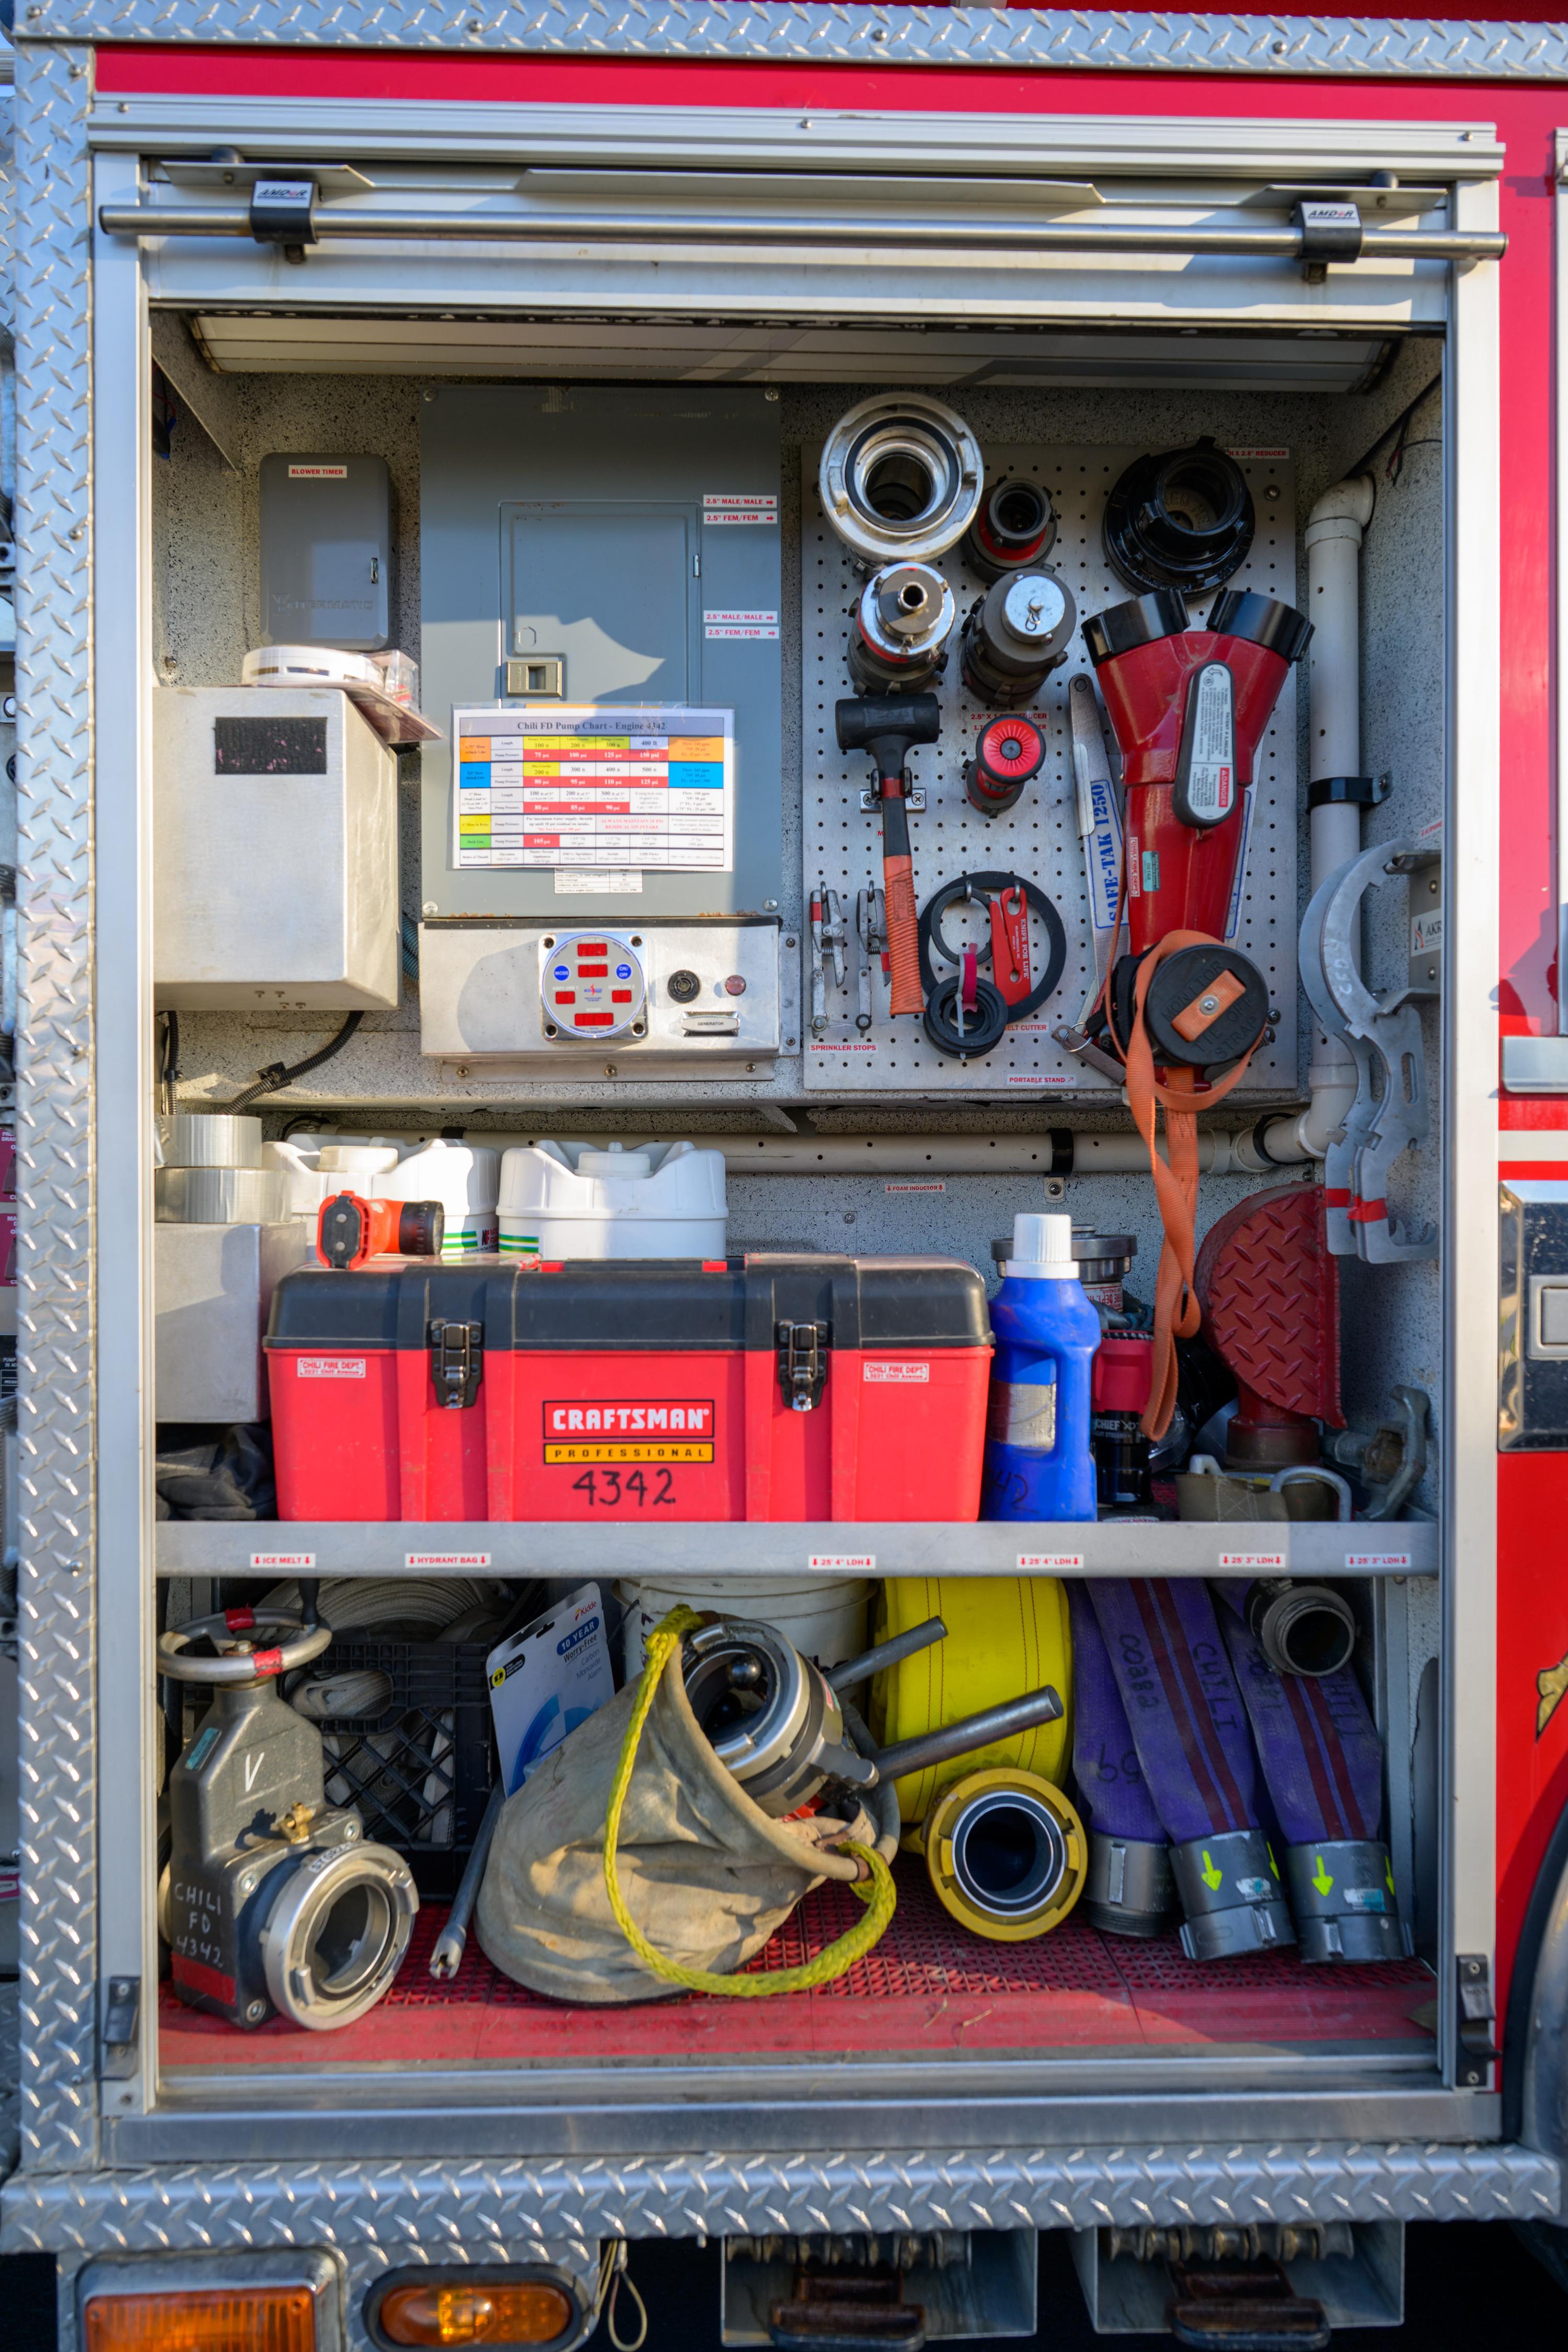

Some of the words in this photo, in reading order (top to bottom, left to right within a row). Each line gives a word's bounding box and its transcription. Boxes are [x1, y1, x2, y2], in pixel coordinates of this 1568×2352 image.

[556, 722, 579, 731] Pump
[616, 722, 644, 731] Engine
[1091, 784, 1109, 826] 1250
[1161, 961, 1225, 1020] MONITOR
[1214, 1015, 1257, 1059] STRAP
[1093, 1419, 1120, 1431] CHIEF
[555, 1448, 705, 1458] PROFESSIONAL
[572, 1467, 676, 1507] 4342
[580, 1600, 597, 1617] Kidde
[561, 1641, 571, 1651] 10
[573, 1621, 595, 1641] YEAR
[563, 1634, 597, 1663] Worry-Free
[576, 1657, 602, 1681] Monoxide
[581, 1647, 600, 1666] Carbon
[587, 1666, 603, 1681] Alarm
[1192, 1641, 1237, 1731] CHILI
[174, 1882, 221, 1917] CHILI
[189, 1911, 211, 1934] FD
[177, 1935, 223, 1968] 4342
